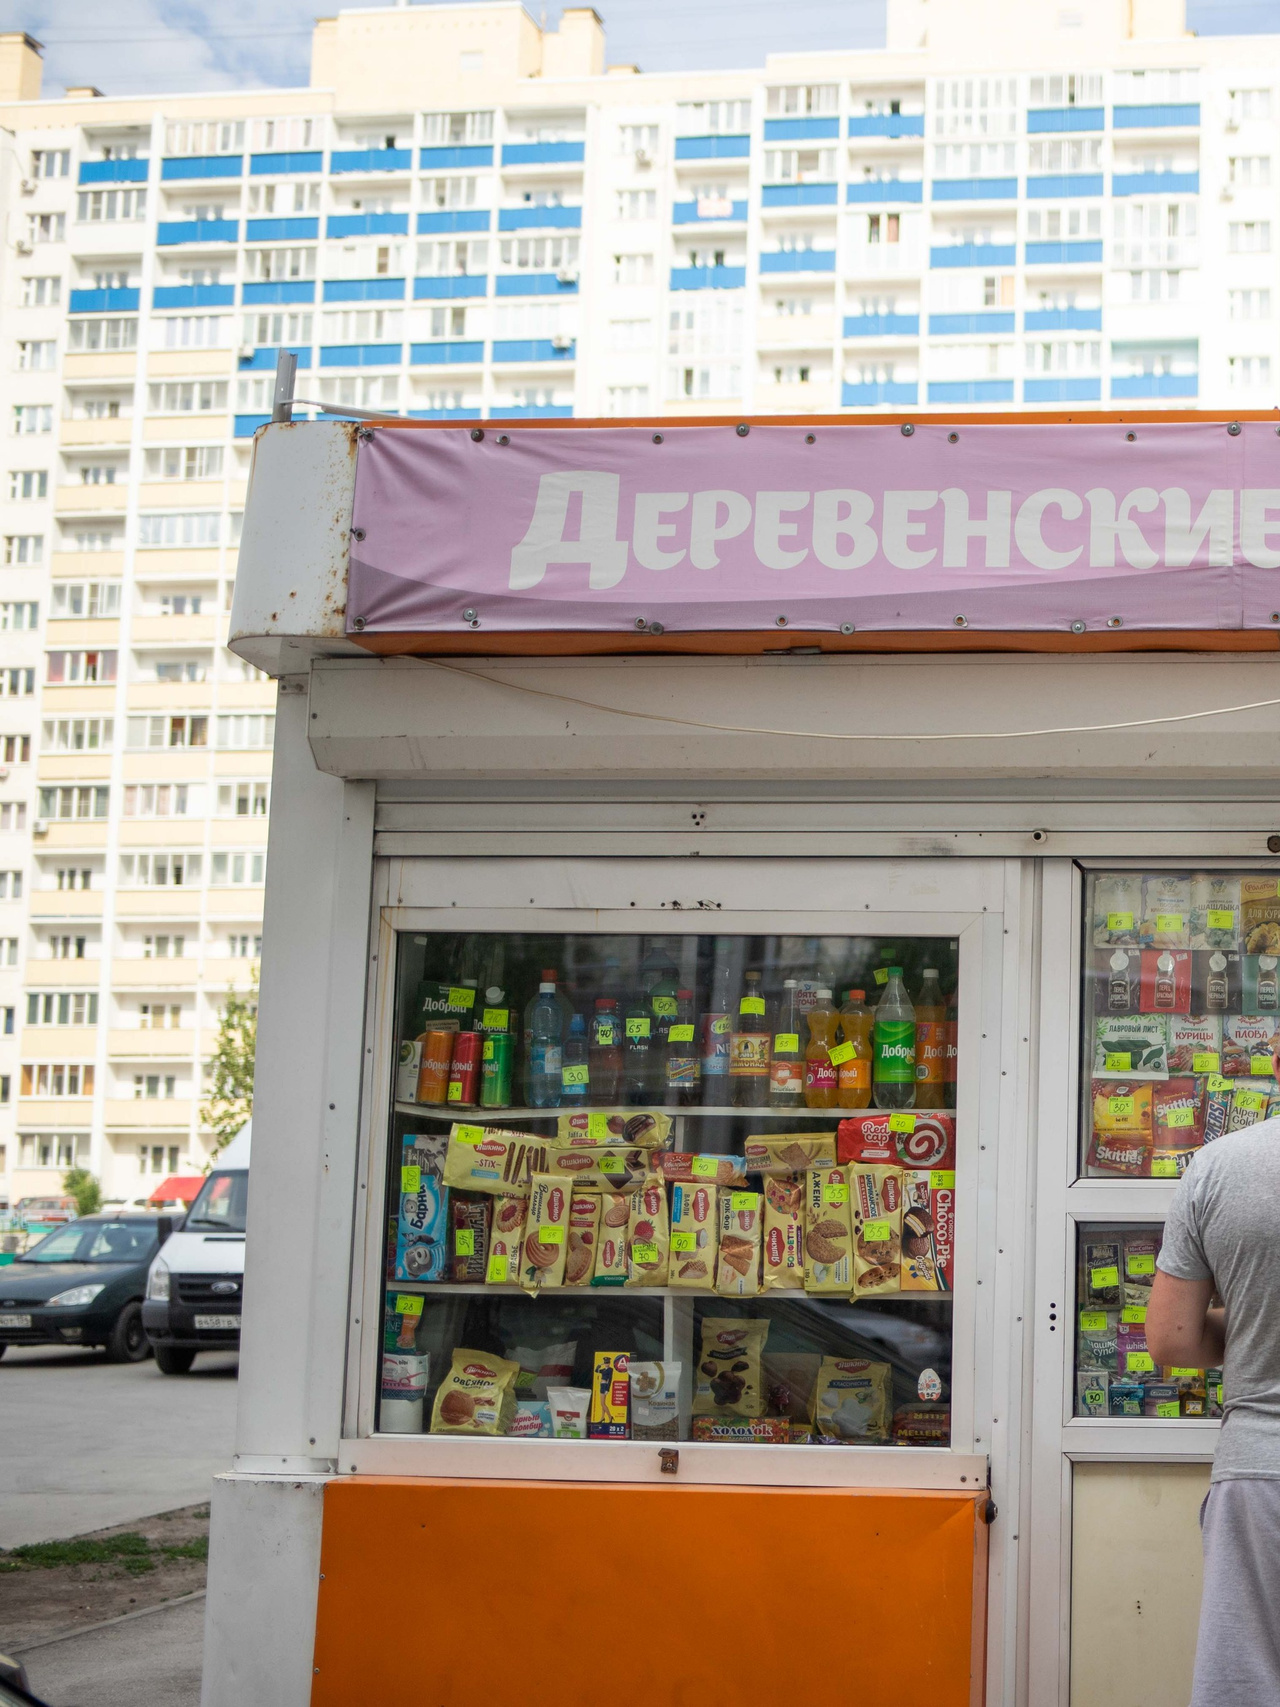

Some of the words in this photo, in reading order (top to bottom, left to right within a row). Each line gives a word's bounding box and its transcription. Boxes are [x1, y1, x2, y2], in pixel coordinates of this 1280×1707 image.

[1246, 910, 1263, 919] ДЛЯ
[628, 1023, 642, 1034] 65
[1108, 1024, 1141, 1033] ЛАВРОВЫЙ
[1142, 1024, 1159, 1034] ЛИСТ
[1175, 1032, 1214, 1042] КУРИЦЫ
[1234, 1030, 1268, 1040] ПЛОВА
[629, 1045, 649, 1053] FLASH
[778, 1040, 788, 1049] 55
[1110, 1059, 1121, 1067] 25
[1199, 1059, 1210, 1068] 20
[568, 1072, 583, 1082] 30
[1211, 1079, 1224, 1088] 65
[1231, 1106, 1259, 1118] Alpen
[896, 1120, 906, 1129] 70
[1232, 1115, 1256, 1126] Gold
[861, 1121, 890, 1135] Red
[863, 1132, 890, 1146] cap
[1096, 1145, 1143, 1165] Skittles
[560, 1157, 591, 1167] Яшкино
[698, 1164, 709, 1172] 40
[812, 1170, 821, 1209] ДЖЕНС
[829, 1187, 844, 1199] 55
[886, 1178, 897, 1211] Яшкино
[551, 1189, 561, 1221] Яшкино
[696, 1190, 706, 1221] Яшкино
[869, 1227, 883, 1237] 55
[677, 1240, 688, 1249] 90
[771, 1230, 781, 1264] Яшкино
[402, 1302, 414, 1313] 28
[1088, 1318, 1098, 1327] 25
[1126, 1342, 1149, 1350] whisk
[897, 1428, 942, 1437] MELLER
